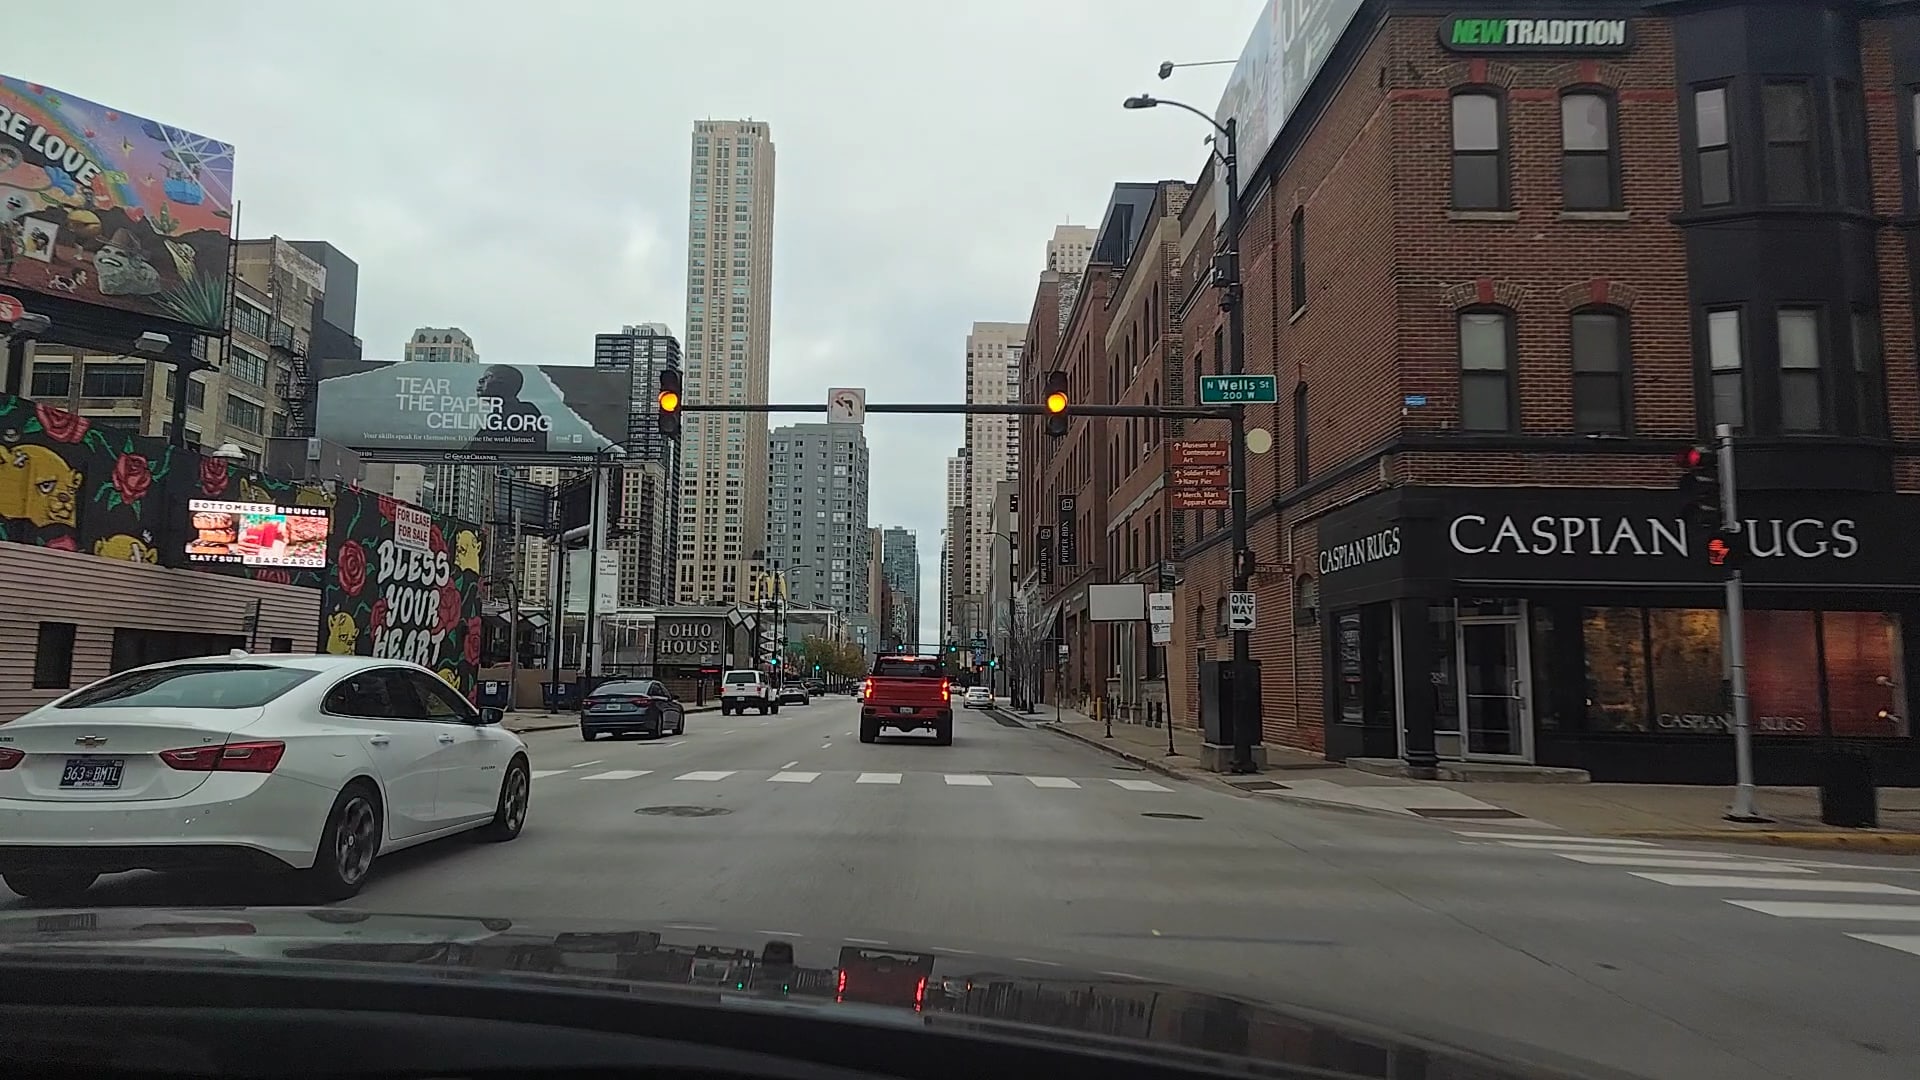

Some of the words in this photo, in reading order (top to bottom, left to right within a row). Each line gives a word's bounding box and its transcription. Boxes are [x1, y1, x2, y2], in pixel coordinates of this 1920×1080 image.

[29, 126, 101, 187] LOVE
[396, 377, 451, 395] TEAR
[1206, 381, 1214, 389] N
[1218, 379, 1256, 391] Wells
[1259, 380, 1270, 389] St
[395, 394, 434, 411] THE
[441, 397, 503, 413] PAPER
[1222, 391, 1243, 400] 200
[1247, 391, 1256, 399] W
[426, 412, 553, 432] CEILING.ORG
[194, 502, 271, 513] BOTTOMLESS
[277, 507, 326, 516] BRUNCH
[1183, 499, 1206, 507] Apparel
[397, 508, 410, 523] FOR
[411, 511, 430, 528] LEASE
[398, 524, 412, 538] FOR
[412, 528, 428, 543] SALE
[1061, 520, 1069, 537] BOX
[1449, 515, 1689, 557] CASPIAN
[1727, 519, 1859, 558] UGS
[1061, 539, 1069, 563] PAPER
[1319, 537, 1366, 575] CASPIAN
[1366, 526, 1401, 563] RUGS
[282, 559, 323, 567] CARGO
[377, 539, 450, 587] BLESS
[385, 583, 441, 628] YOUR
[1231, 595, 1254, 605] ONE
[1231, 605, 1254, 615] WAY
[669, 623, 712, 637] OHIO
[372, 625, 446, 667] HEART
[660, 640, 720, 654] HOUSE
[1656, 713, 1736, 729] CASPIAN
[1759, 716, 1807, 731] RUGS
[64, 766, 86, 781] 363
[93, 766, 119, 781] BMTL
